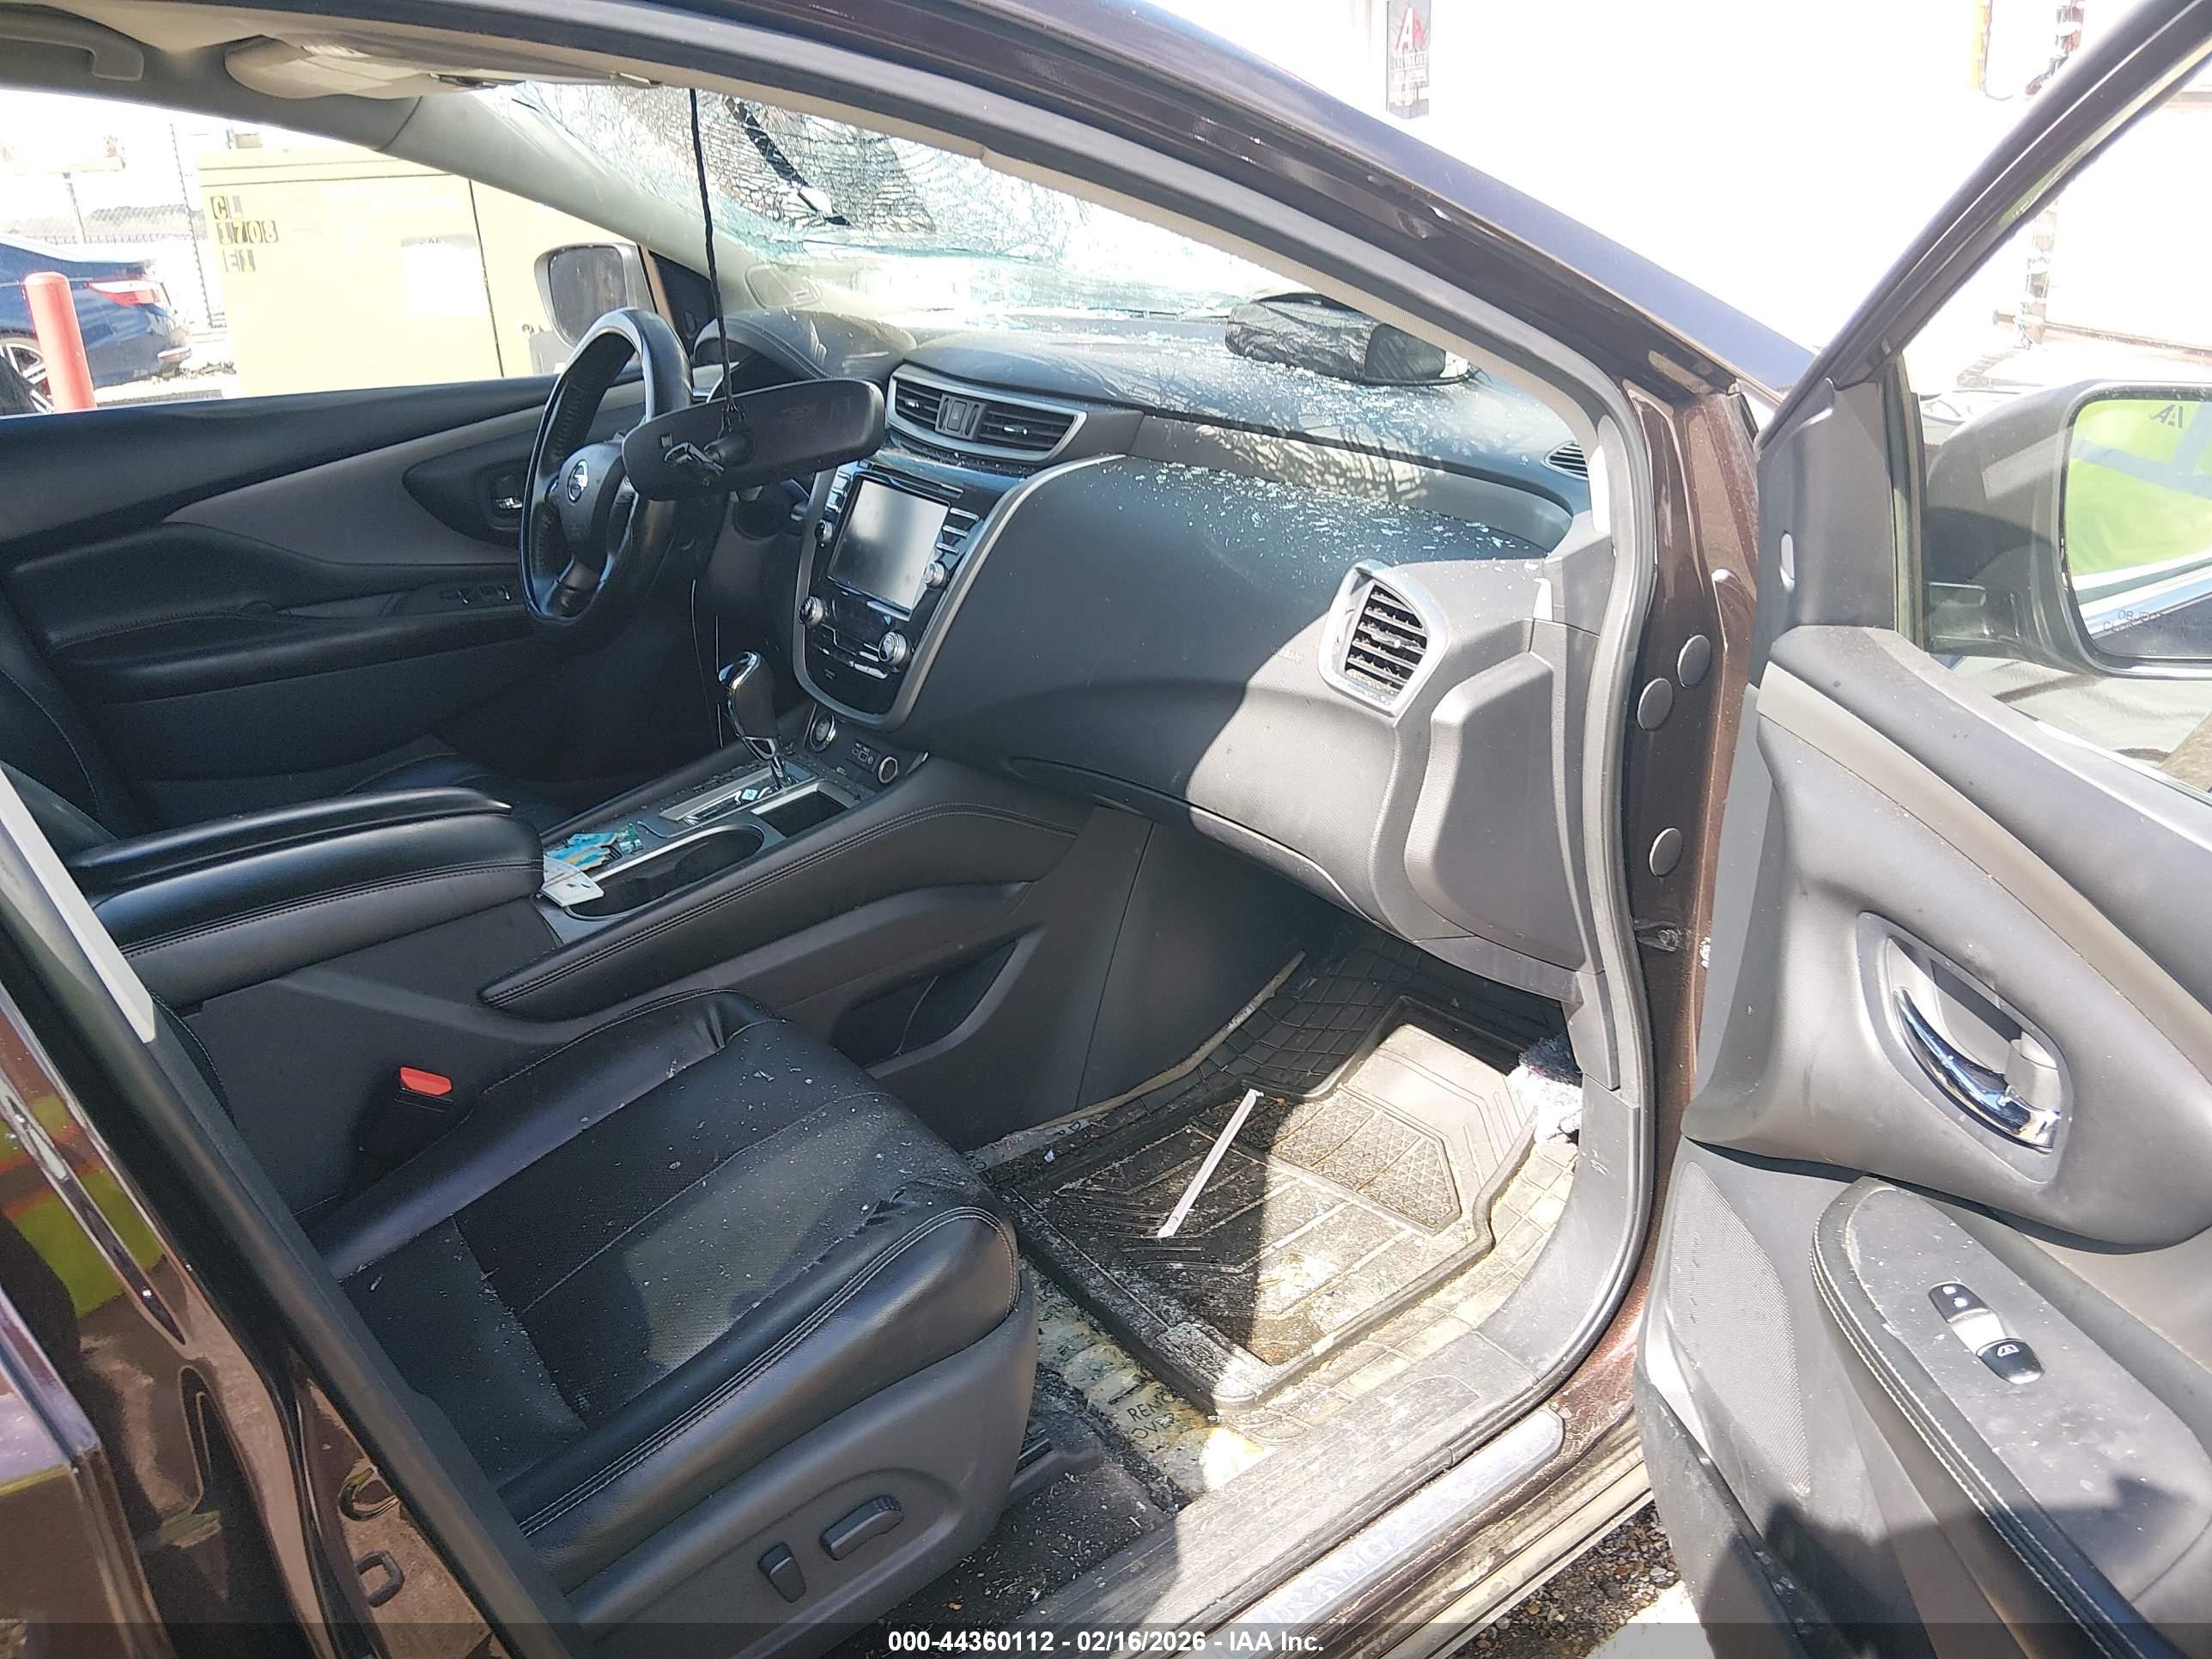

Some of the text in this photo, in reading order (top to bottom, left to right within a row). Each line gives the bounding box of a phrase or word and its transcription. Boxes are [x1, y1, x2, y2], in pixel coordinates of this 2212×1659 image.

[210, 195, 243, 219] CL
[216, 221, 278, 244] 1708
[1127, 1391, 1176, 1422] REMO
